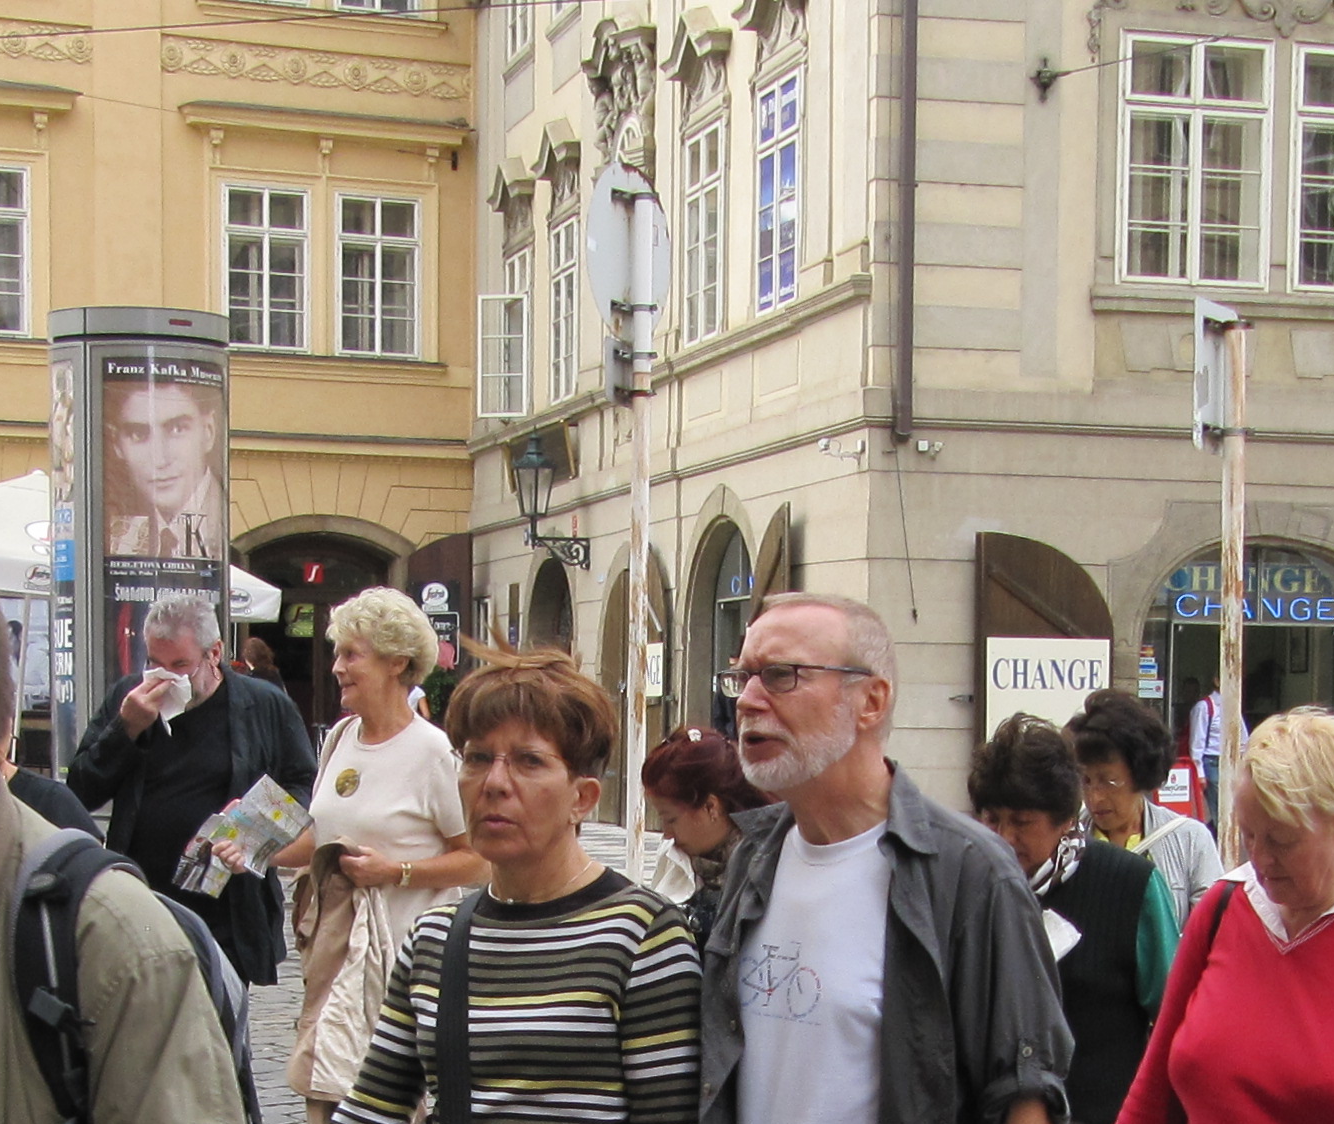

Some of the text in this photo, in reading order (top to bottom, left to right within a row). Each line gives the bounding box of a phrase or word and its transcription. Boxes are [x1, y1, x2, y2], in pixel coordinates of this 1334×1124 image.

[108, 362, 145, 374] Franz
[150, 363, 187, 376] Kafka
[992, 657, 1103, 691] CHANGE
